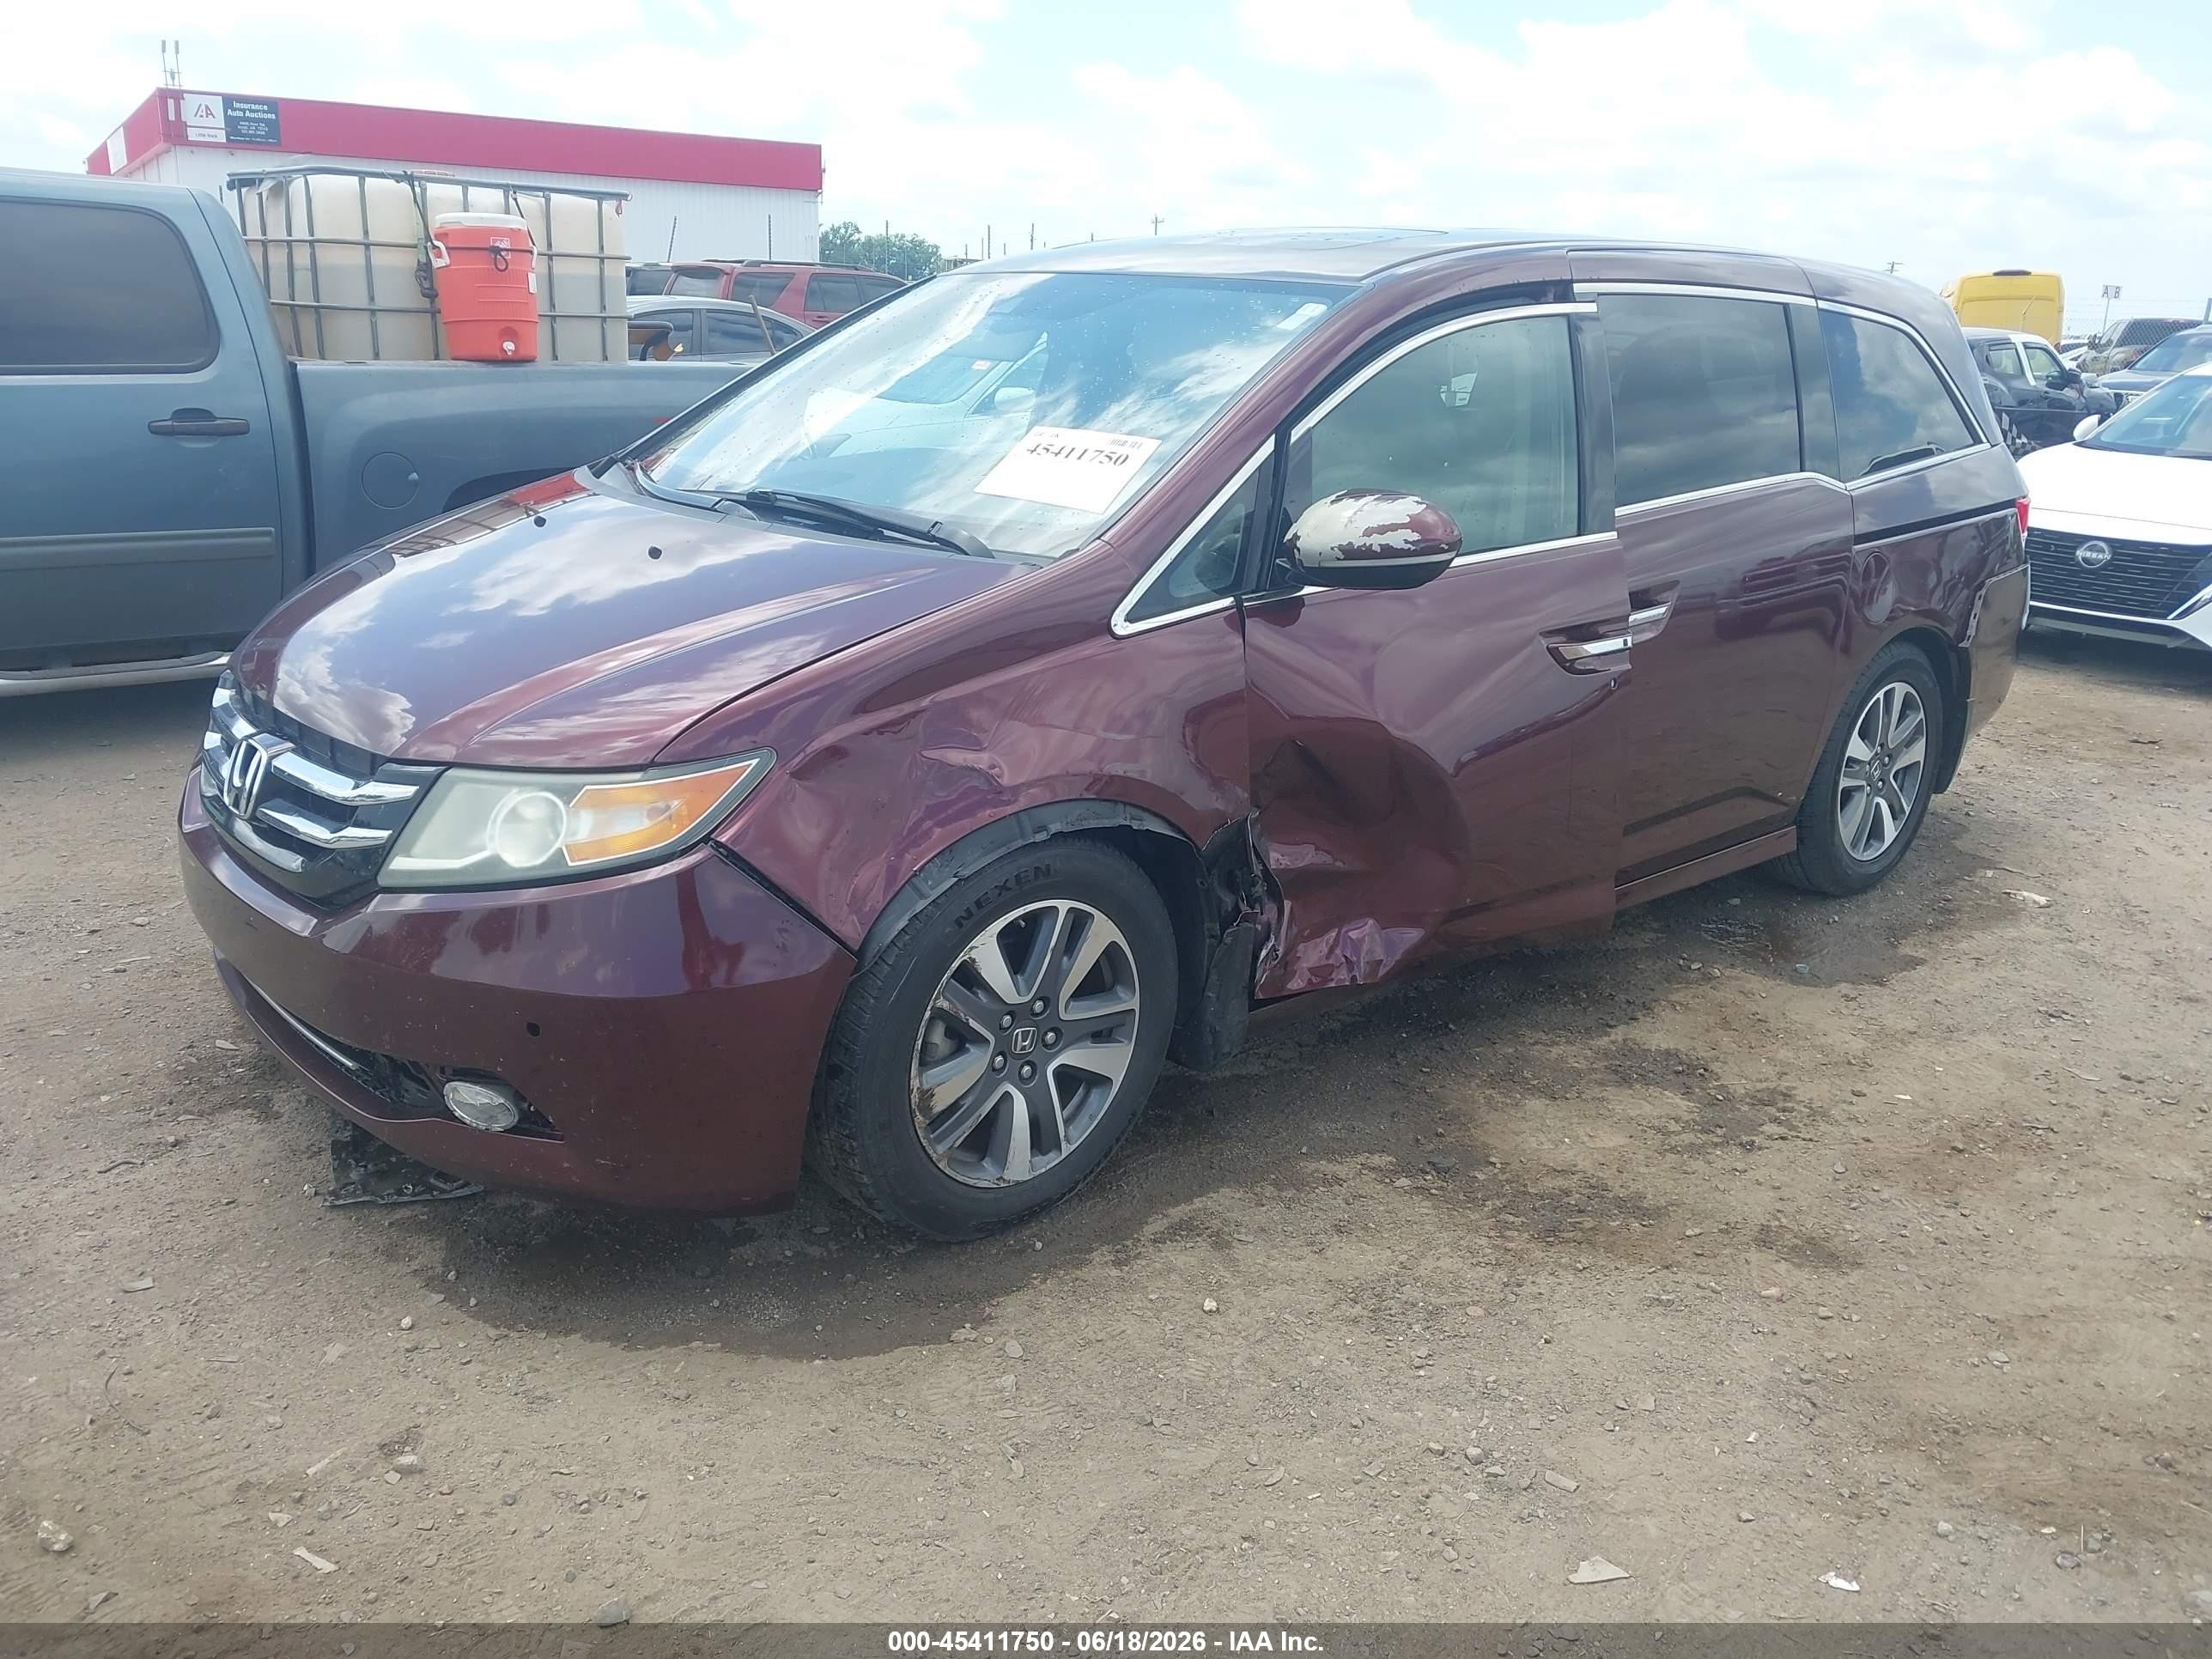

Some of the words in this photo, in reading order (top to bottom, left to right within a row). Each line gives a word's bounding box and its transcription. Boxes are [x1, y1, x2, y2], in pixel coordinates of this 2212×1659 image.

[233, 100, 268, 111] Insurance
[245, 110, 276, 119] Auctions
[2102, 286, 2109, 298] A
[2114, 286, 2121, 299] B
[1026, 442, 1129, 466] 45411750
[2075, 550, 2112, 561] NISSAN
[953, 863, 1051, 929] NEXEN
